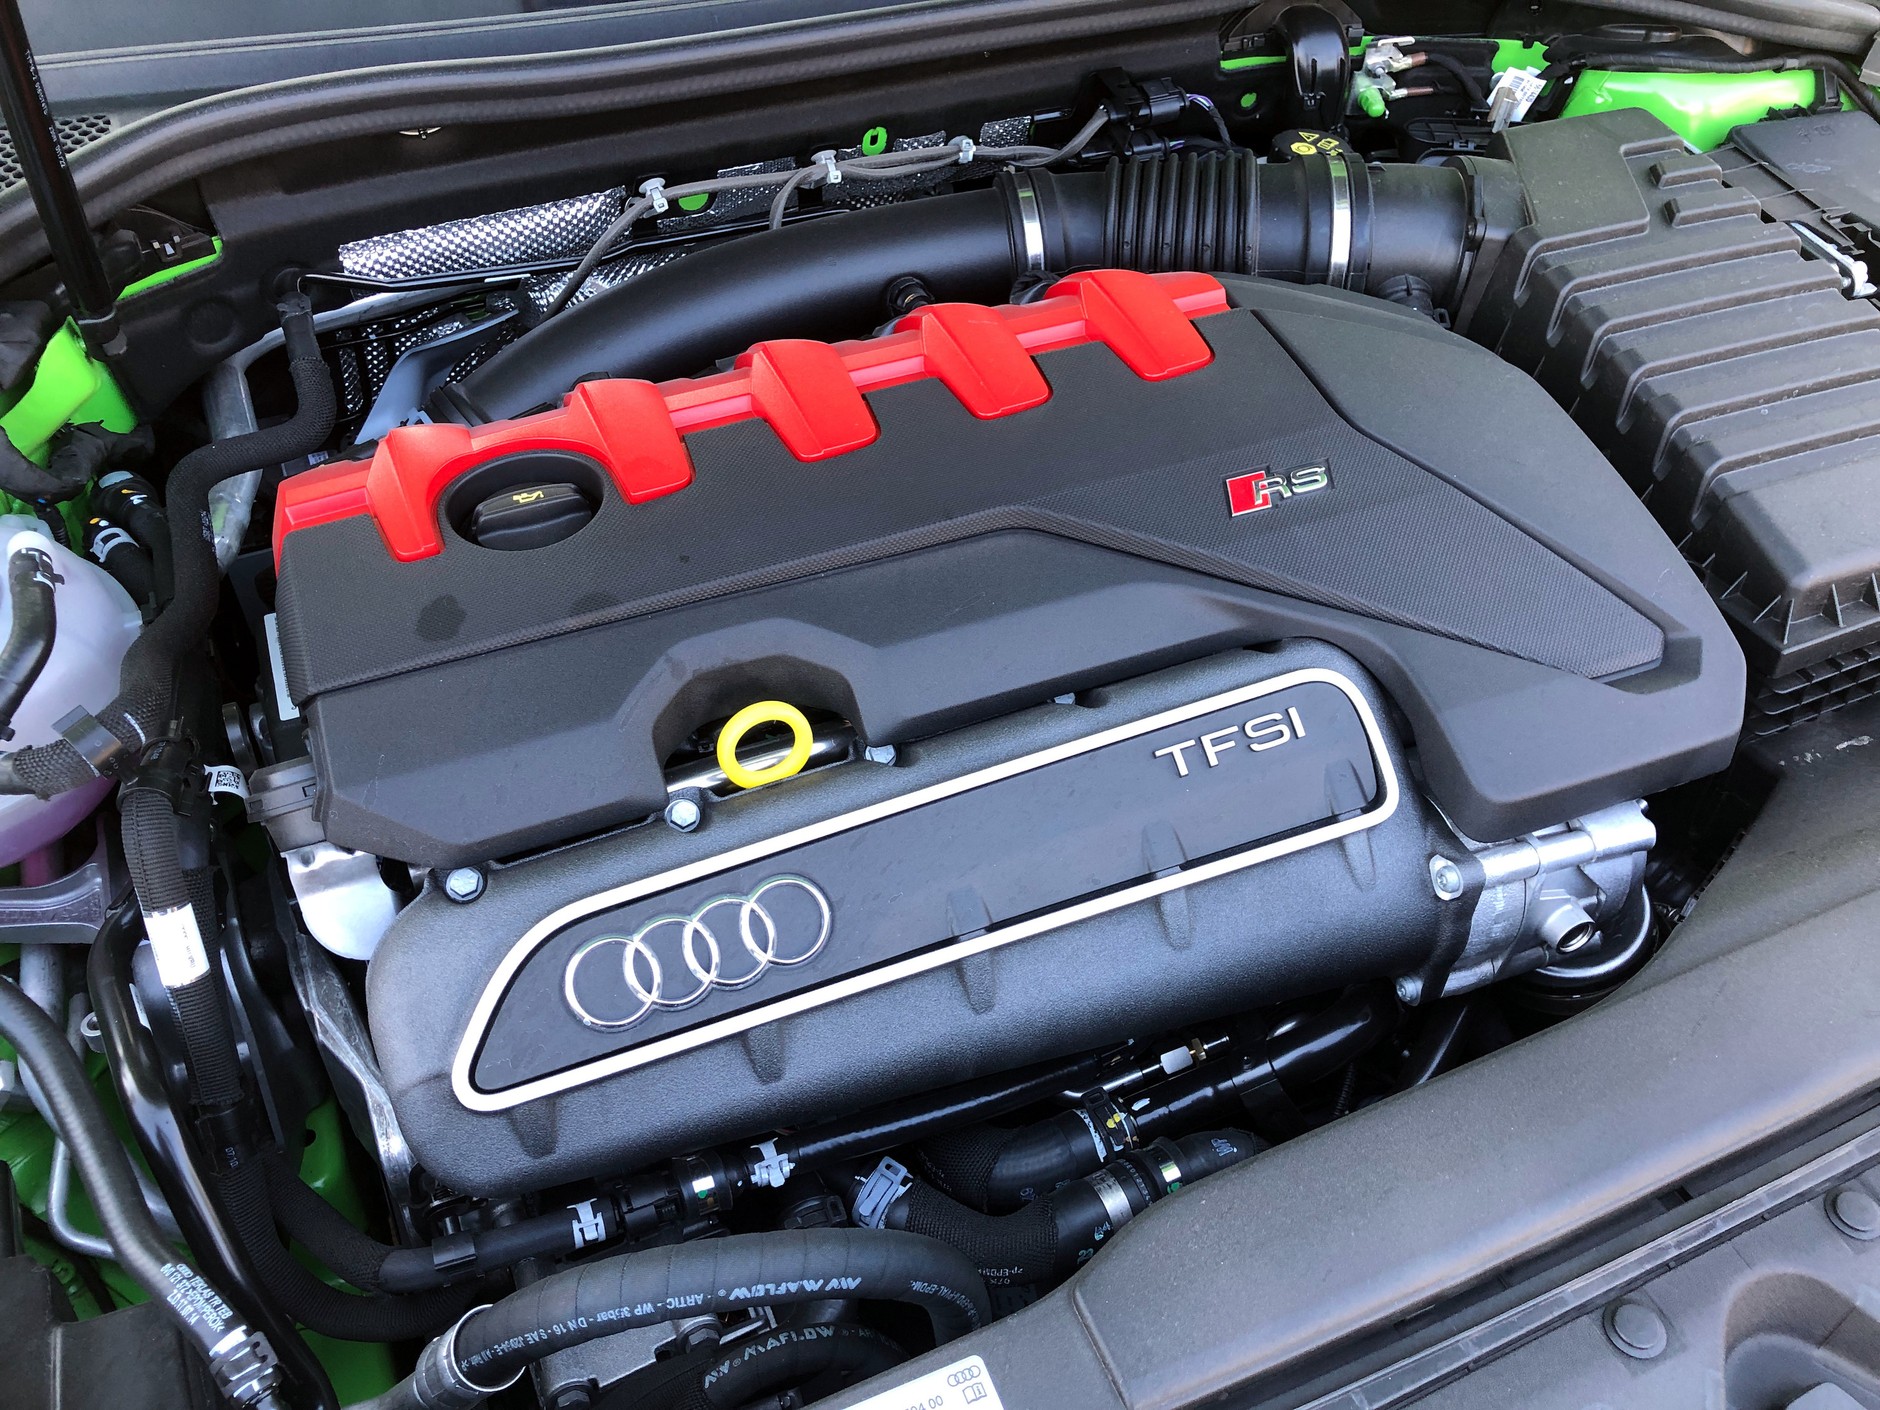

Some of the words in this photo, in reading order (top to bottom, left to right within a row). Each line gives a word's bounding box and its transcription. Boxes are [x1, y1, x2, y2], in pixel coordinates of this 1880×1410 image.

[1252, 464, 1328, 505] RS
[1153, 705, 1306, 778] TFSI
[189, 1276, 215, 1299] TEKLAS
[208, 1295, 223, 1309] TR
[728, 1278, 824, 1301] MAFLOW
[633, 1303, 655, 1316] WP
[666, 1292, 704, 1310] ARTIC
[554, 1322, 567, 1336] 16
[569, 1317, 588, 1332] DN
[526, 1329, 548, 1345] SAE
[743, 1325, 836, 1361] MAFLOW
